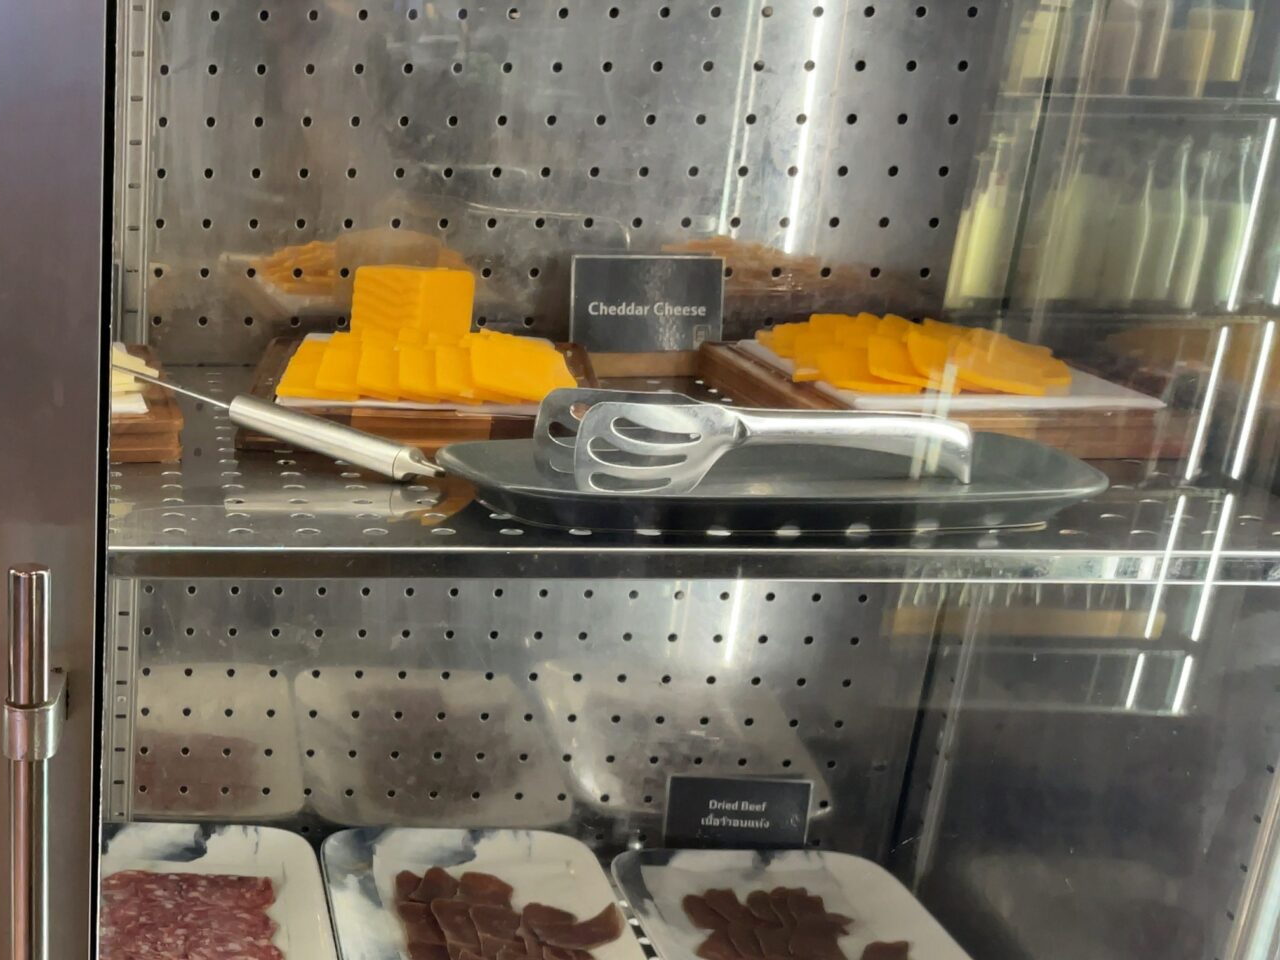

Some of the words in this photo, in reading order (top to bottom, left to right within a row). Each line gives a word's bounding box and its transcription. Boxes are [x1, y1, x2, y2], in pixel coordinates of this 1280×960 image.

[587, 301, 650, 316] Cheddar
[653, 301, 707, 317] Cheese
[708, 799, 739, 811] Dried
[740, 800, 768, 812] Beef
